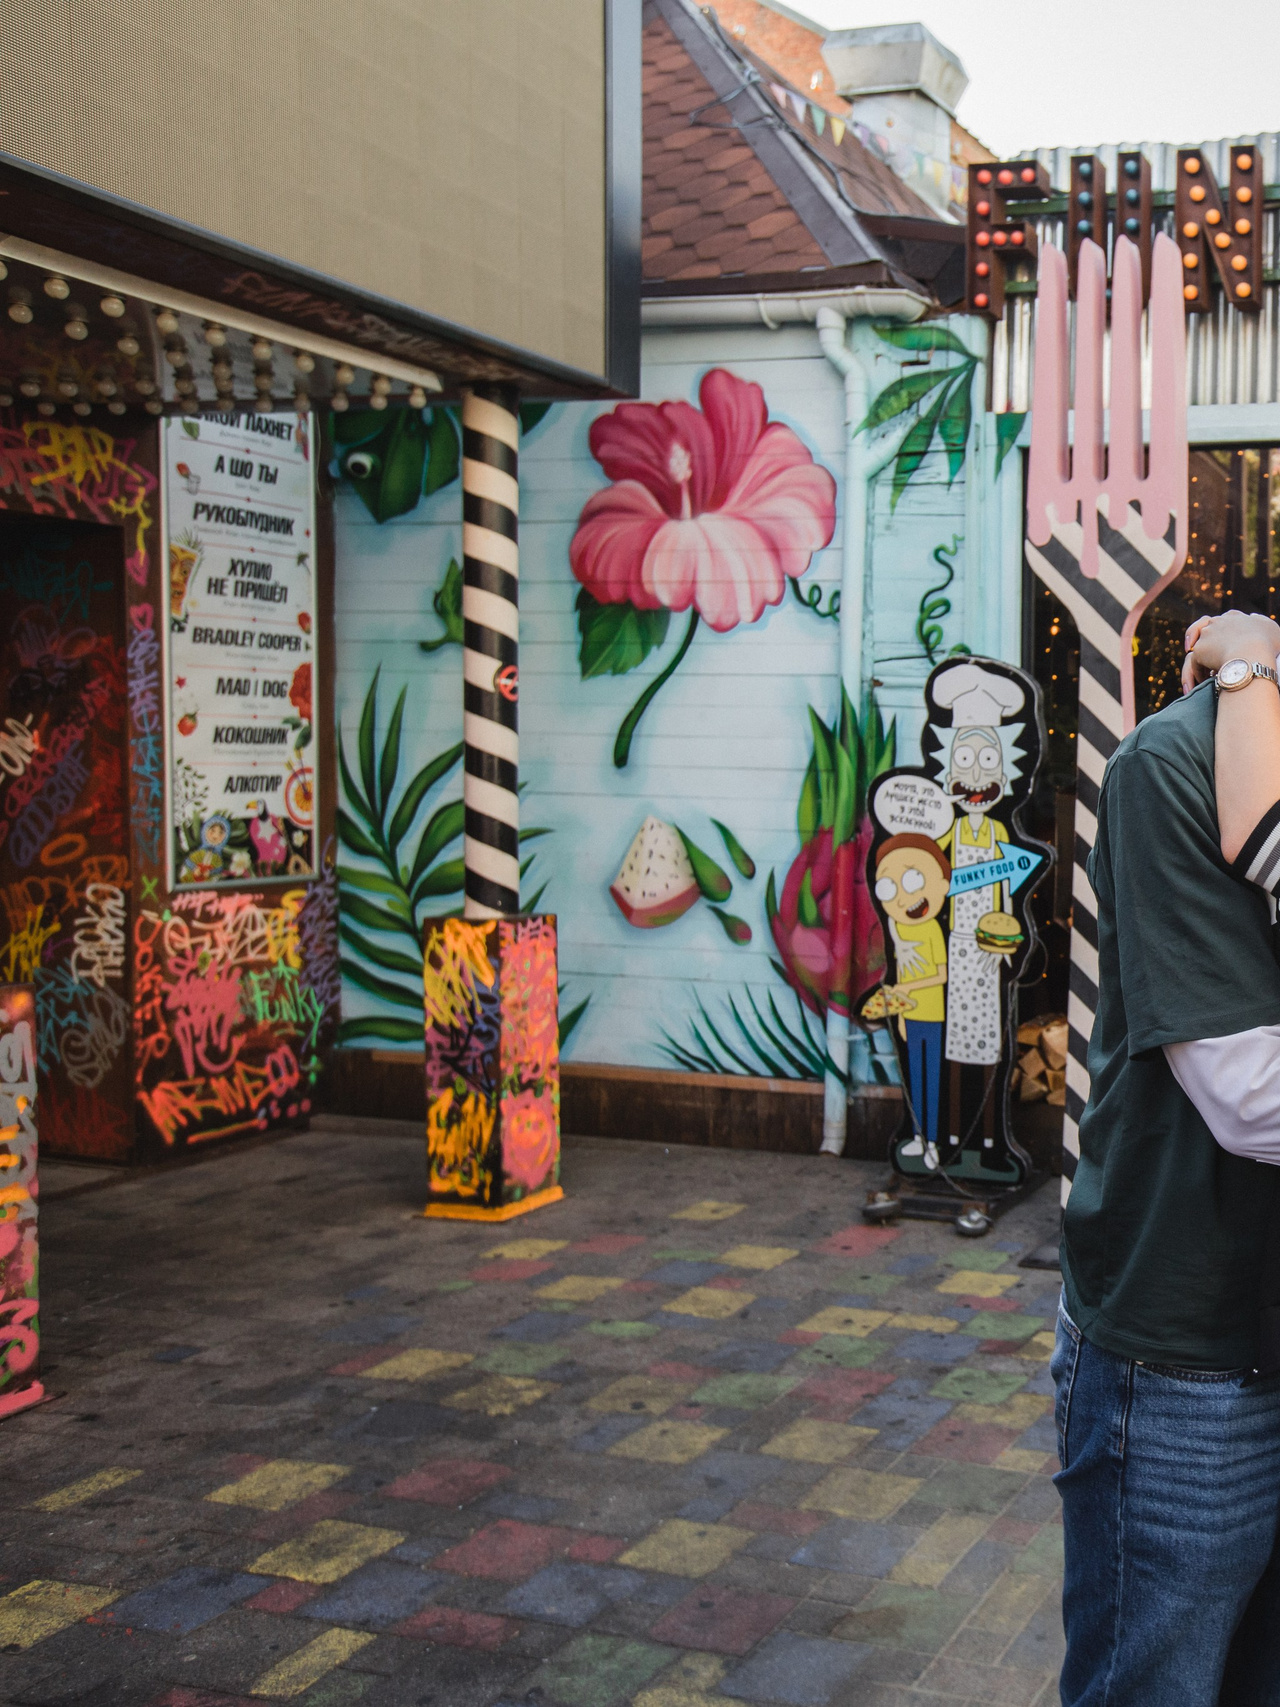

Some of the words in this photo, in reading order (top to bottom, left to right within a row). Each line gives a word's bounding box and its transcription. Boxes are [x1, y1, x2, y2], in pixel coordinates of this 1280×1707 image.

[245, 412, 293, 441] ПАХНЕТ
[214, 454, 225, 473] А
[230, 457, 253, 479] ШО
[258, 463, 279, 485] ТЫ
[193, 502, 294, 535] РУКОБЛУДНИК
[228, 558, 272, 581] ХУЛИО
[207, 577, 229, 596] НЕ
[234, 579, 288, 603] ПРИШЁЛ
[193, 627, 255, 648] BRADLEY
[258, 631, 302, 651] COOPER
[216, 677, 250, 697] MAD
[262, 680, 288, 698] DOG
[213, 726, 289, 745] КОКОШНИК
[224, 775, 282, 793] АЛКОТИР
[917, 797, 942, 809] МЕСТО
[953, 868, 986, 886] FUNKY
[990, 861, 1015, 876] FOOD
